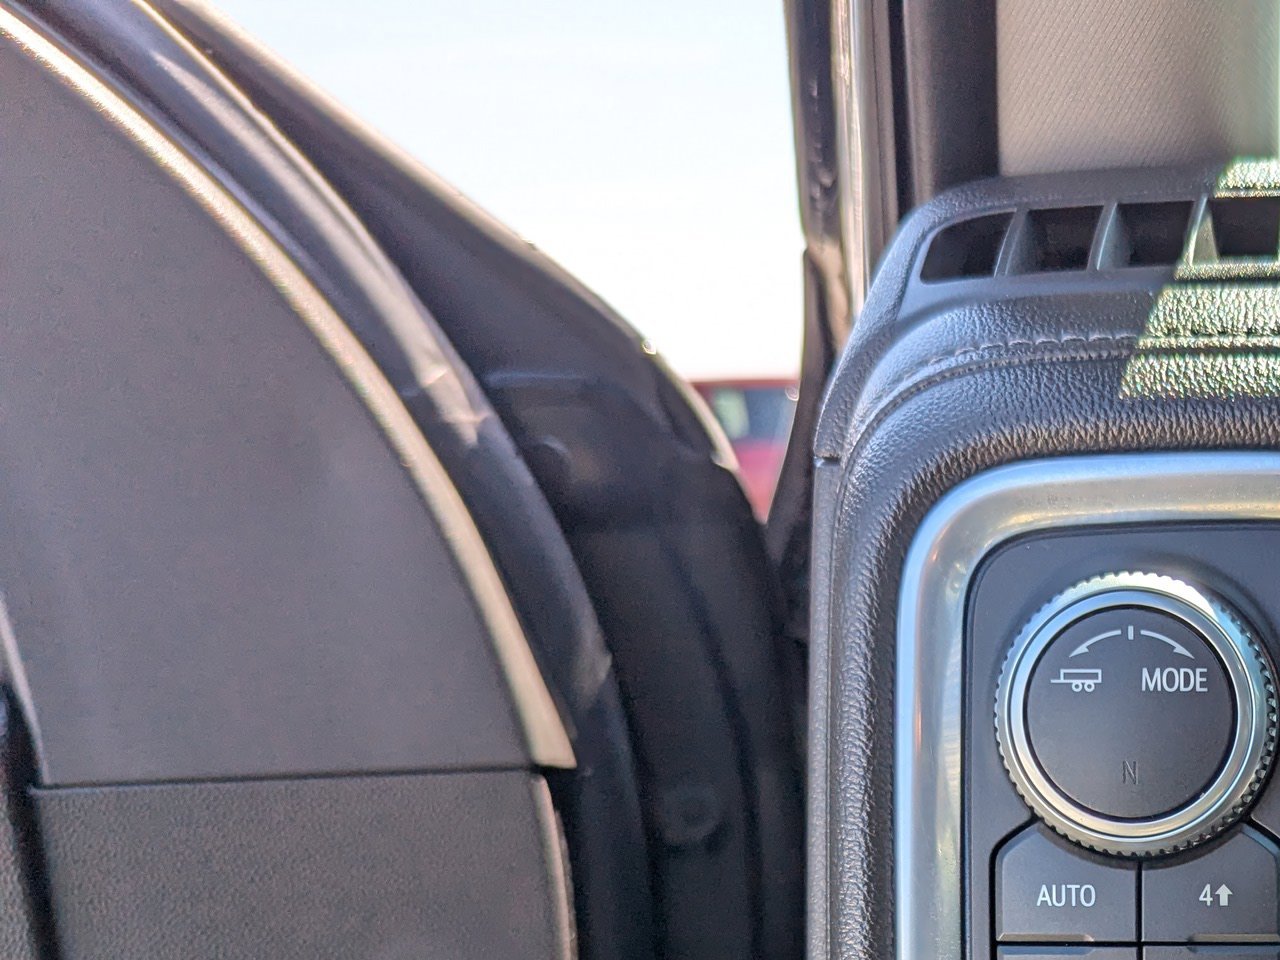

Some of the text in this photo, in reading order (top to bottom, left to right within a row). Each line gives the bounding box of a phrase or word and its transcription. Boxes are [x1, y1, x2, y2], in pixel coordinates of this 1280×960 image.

[1141, 667, 1209, 693] MODE
[1036, 884, 1096, 907] AUTO
[1198, 884, 1213, 906] 4
